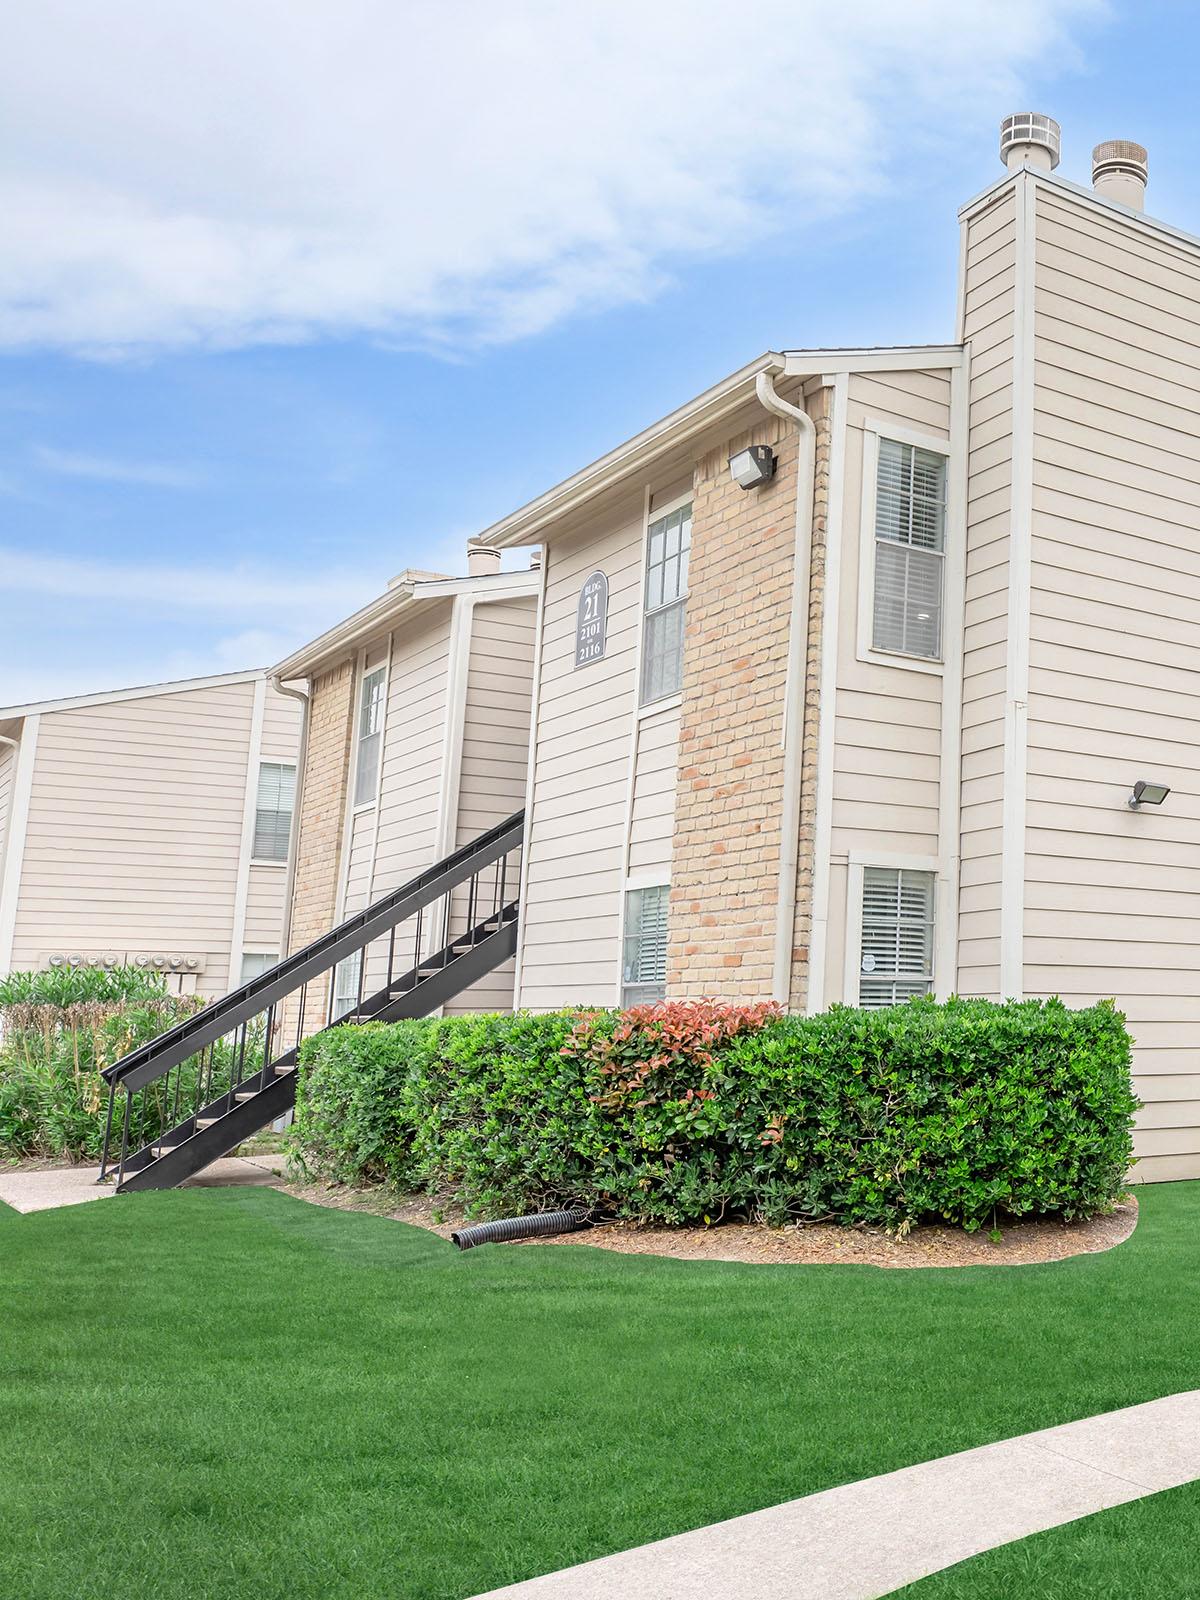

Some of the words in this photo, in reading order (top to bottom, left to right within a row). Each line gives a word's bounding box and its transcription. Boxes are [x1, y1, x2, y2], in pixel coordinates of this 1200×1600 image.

[584, 593, 598, 621] 21
[580, 622, 600, 641] 2101
[579, 642, 600, 661] 2116
